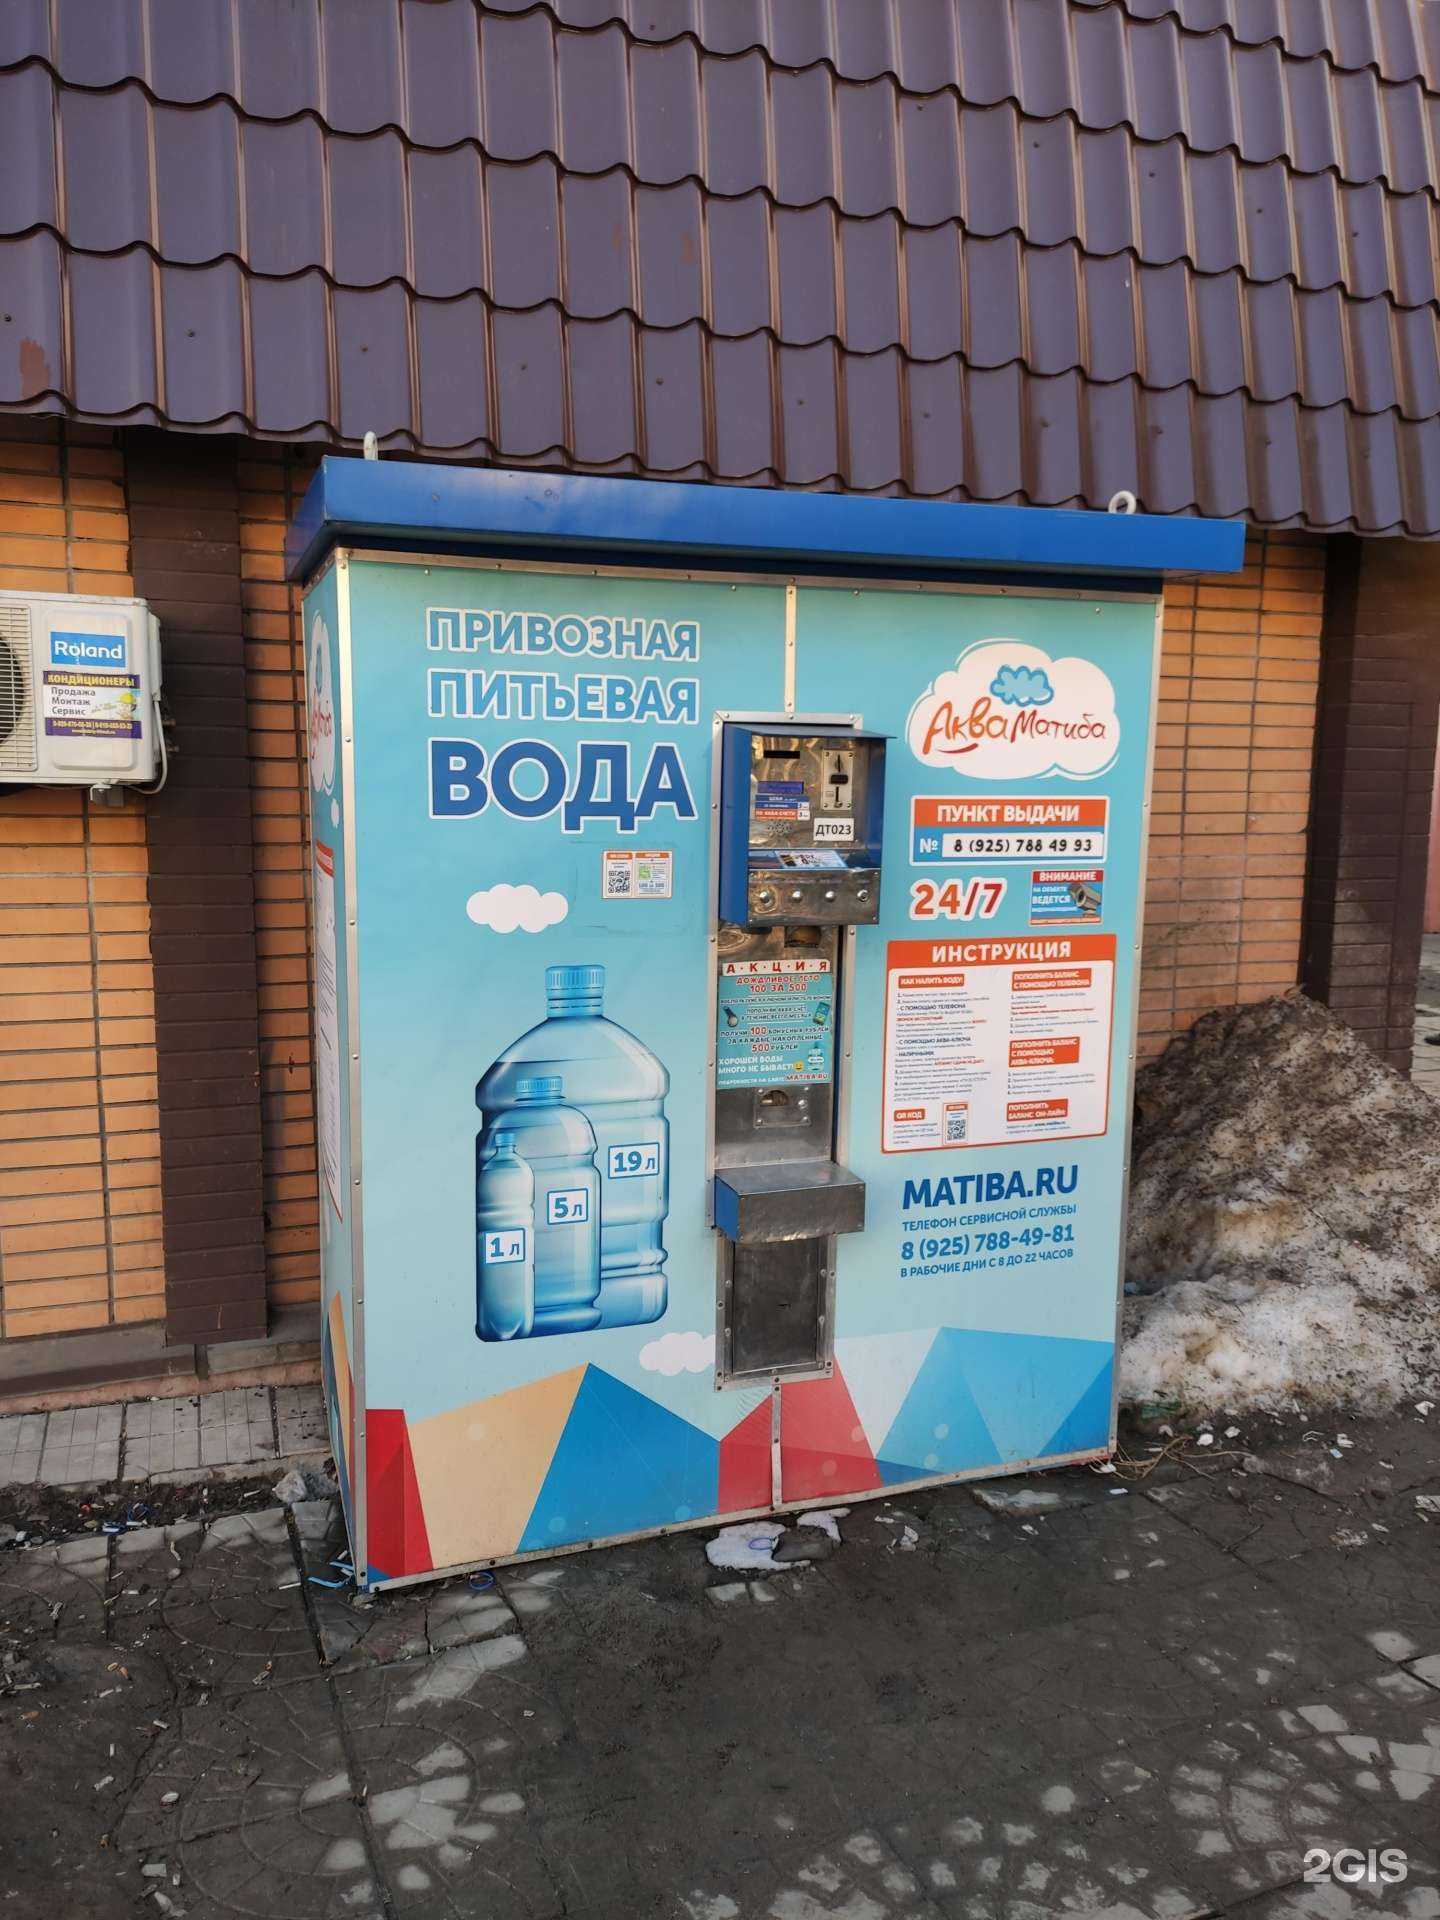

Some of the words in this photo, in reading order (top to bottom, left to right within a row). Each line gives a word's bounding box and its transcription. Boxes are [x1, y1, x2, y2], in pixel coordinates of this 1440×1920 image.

[427, 608, 698, 661] ПРИВОЗНАЯ
[54, 640, 122, 659] Roland
[48, 674, 134, 686] КОНДИЦИОНЕРЫ
[51, 687, 96, 697] Продажа
[52, 697, 90, 705] Монтаж
[428, 669, 698, 724] ПИТЬЕВАЯ
[52, 707, 86, 716] Сервис
[428, 738, 698, 834] ВОДА
[937, 805, 1000, 822] ПУНКТ
[1003, 805, 1080, 824] ВЫДАЧИ
[815, 824, 851, 836] ДТ023
[919, 838, 938, 853] №
[954, 839, 963, 852] 8
[969, 838, 1010, 854] (925)
[1016, 839, 1043, 852] 788
[1049, 839, 1067, 852] 49
[1073, 839, 1092, 852] 93
[1039, 871, 1097, 882] ВНИМАНИЕ
[912, 880, 1004, 917] 24/7
[932, 941, 1072, 963] ИНСТРУКЦИЯ
[788, 983, 807, 991] 500
[750, 1027, 768, 1035] 100
[752, 1044, 769, 1052] 500
[614, 1151, 642, 1172] 19
[645, 1157, 656, 1170] л
[902, 1164, 1078, 1209] MATIBA.RU
[554, 1197, 568, 1218] 5
[571, 1204, 582, 1216] л
[902, 1217, 957, 1231] ТЕЛЕФОН
[959, 1208, 1026, 1226] СЕРВИСНОЙ
[1029, 1204, 1076, 1218] СЛУЖБЫ
[490, 1238, 504, 1257] 1
[509, 1243, 520, 1256] л
[901, 1241, 914, 1260] 8
[919, 1235, 969, 1260] (925)
[974, 1224, 1074, 1252] 788-49-81
[901, 1267, 907, 1277] В
[910, 1262, 960, 1276] РАБОЧИЕ
[962, 1259, 986, 1273] ДНИ
[988, 1258, 995, 1267] С
[1007, 1255, 1023, 1267] ДО
[1025, 1253, 1037, 1263] 22
[1039, 1249, 1074, 1261] ЧАСОВ
